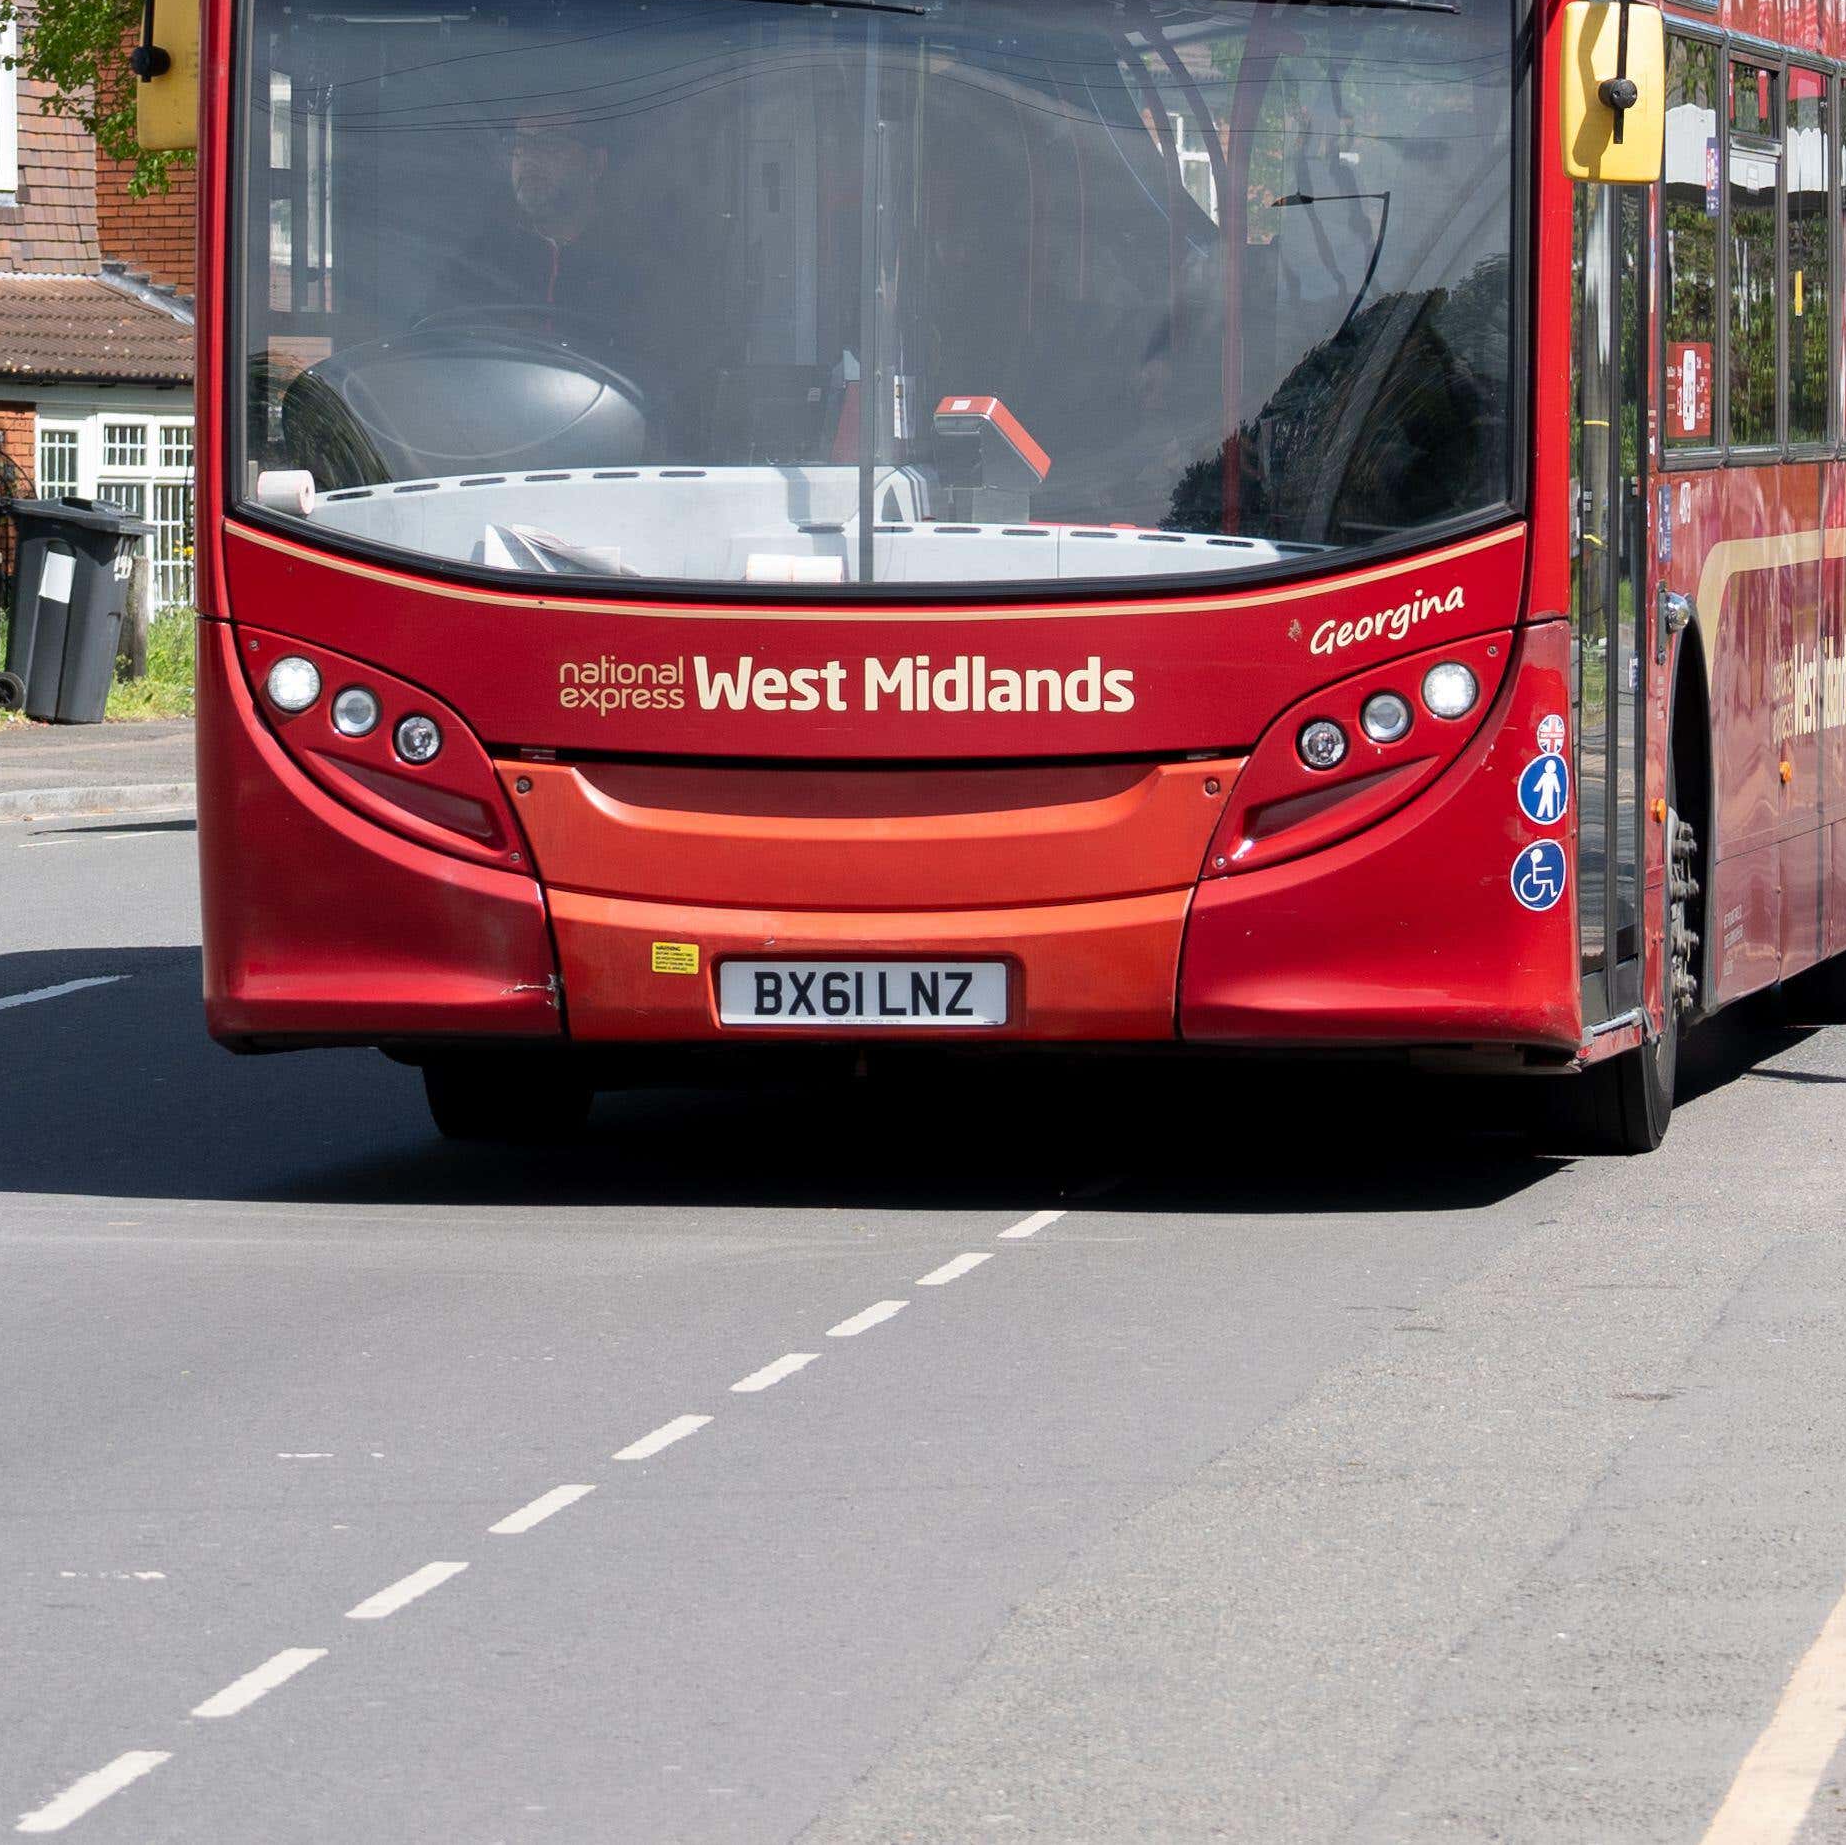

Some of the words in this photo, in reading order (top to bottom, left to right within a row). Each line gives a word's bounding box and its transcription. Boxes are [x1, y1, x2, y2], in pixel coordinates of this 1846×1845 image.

[1309, 585, 1466, 655] Georgina
[558, 655, 684, 685] national
[693, 656, 847, 712] West
[864, 656, 1136, 713] Midlands
[558, 687, 685, 716] express
[754, 971, 864, 1016] BX61
[878, 971, 974, 1016] LNZ
